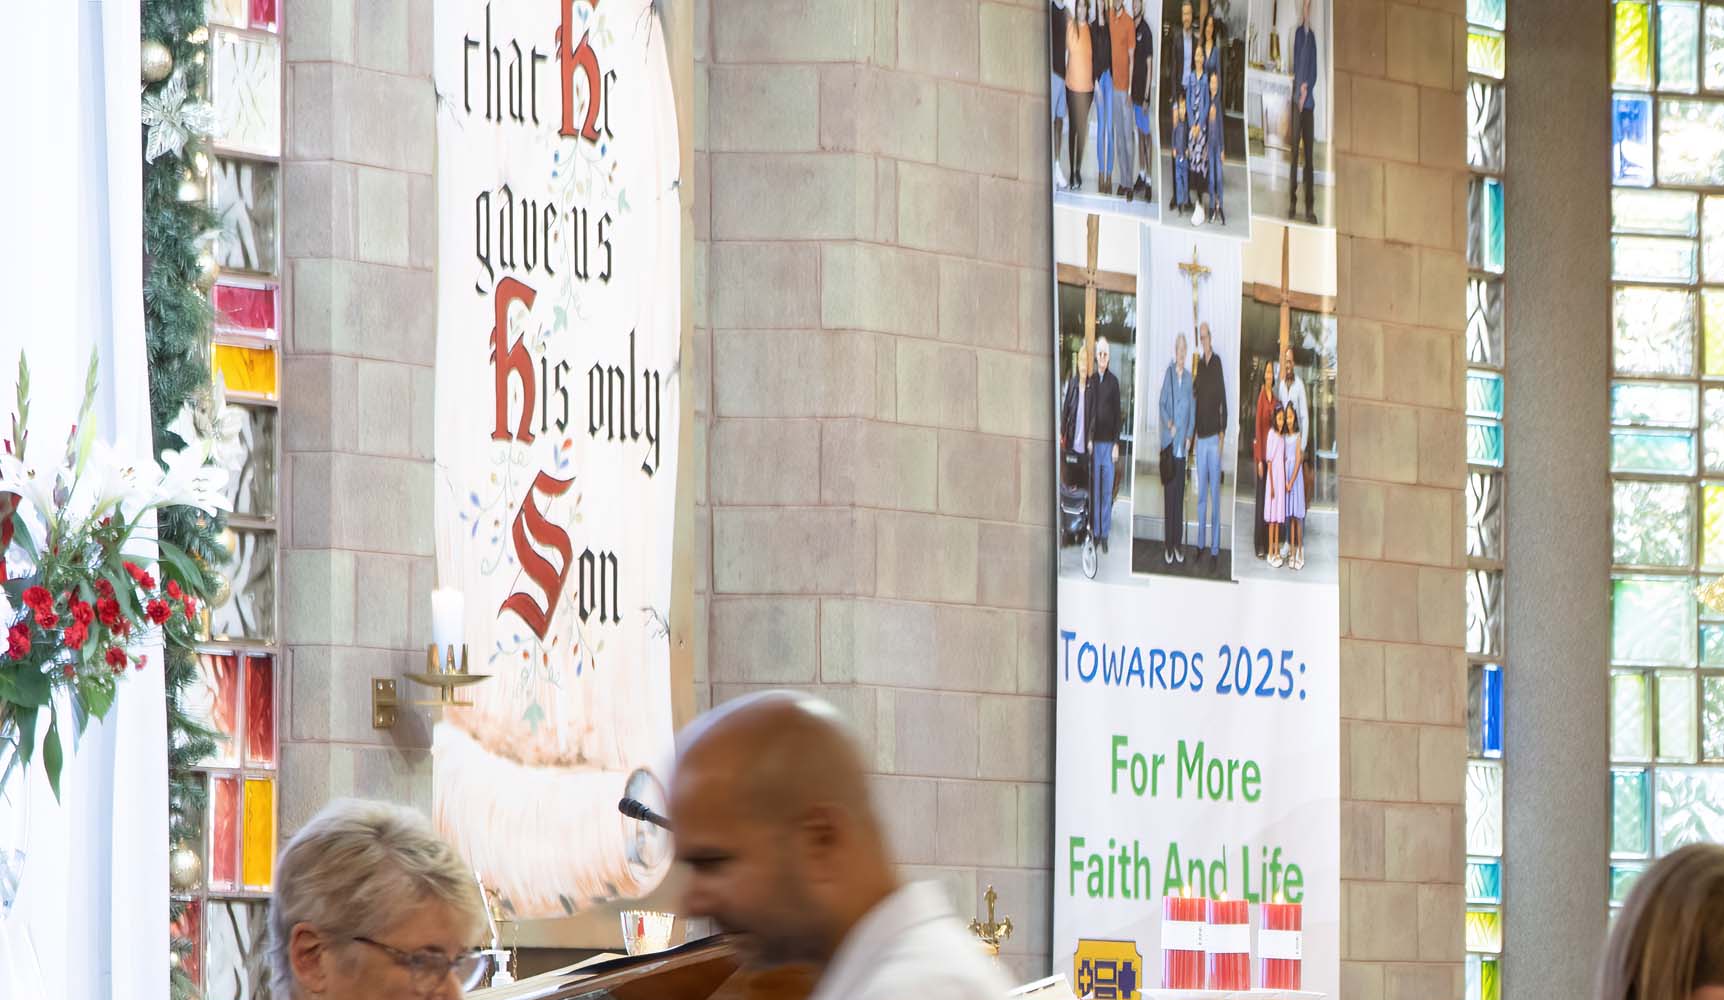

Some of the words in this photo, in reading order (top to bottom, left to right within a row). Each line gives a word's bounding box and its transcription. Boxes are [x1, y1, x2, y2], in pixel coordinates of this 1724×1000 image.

[464, 1, 547, 125] that
[475, 184, 557, 294] gave
[572, 206, 612, 283] us
[587, 328, 662, 478] only
[497, 470, 623, 641] Son
[1215, 644, 1307, 700] 2025:
[1111, 735, 1165, 797] For
[1176, 739, 1261, 803] More
[1069, 836, 1151, 900] Faith
[1163, 842, 1227, 901] And
[1241, 845, 1304, 904] Life
